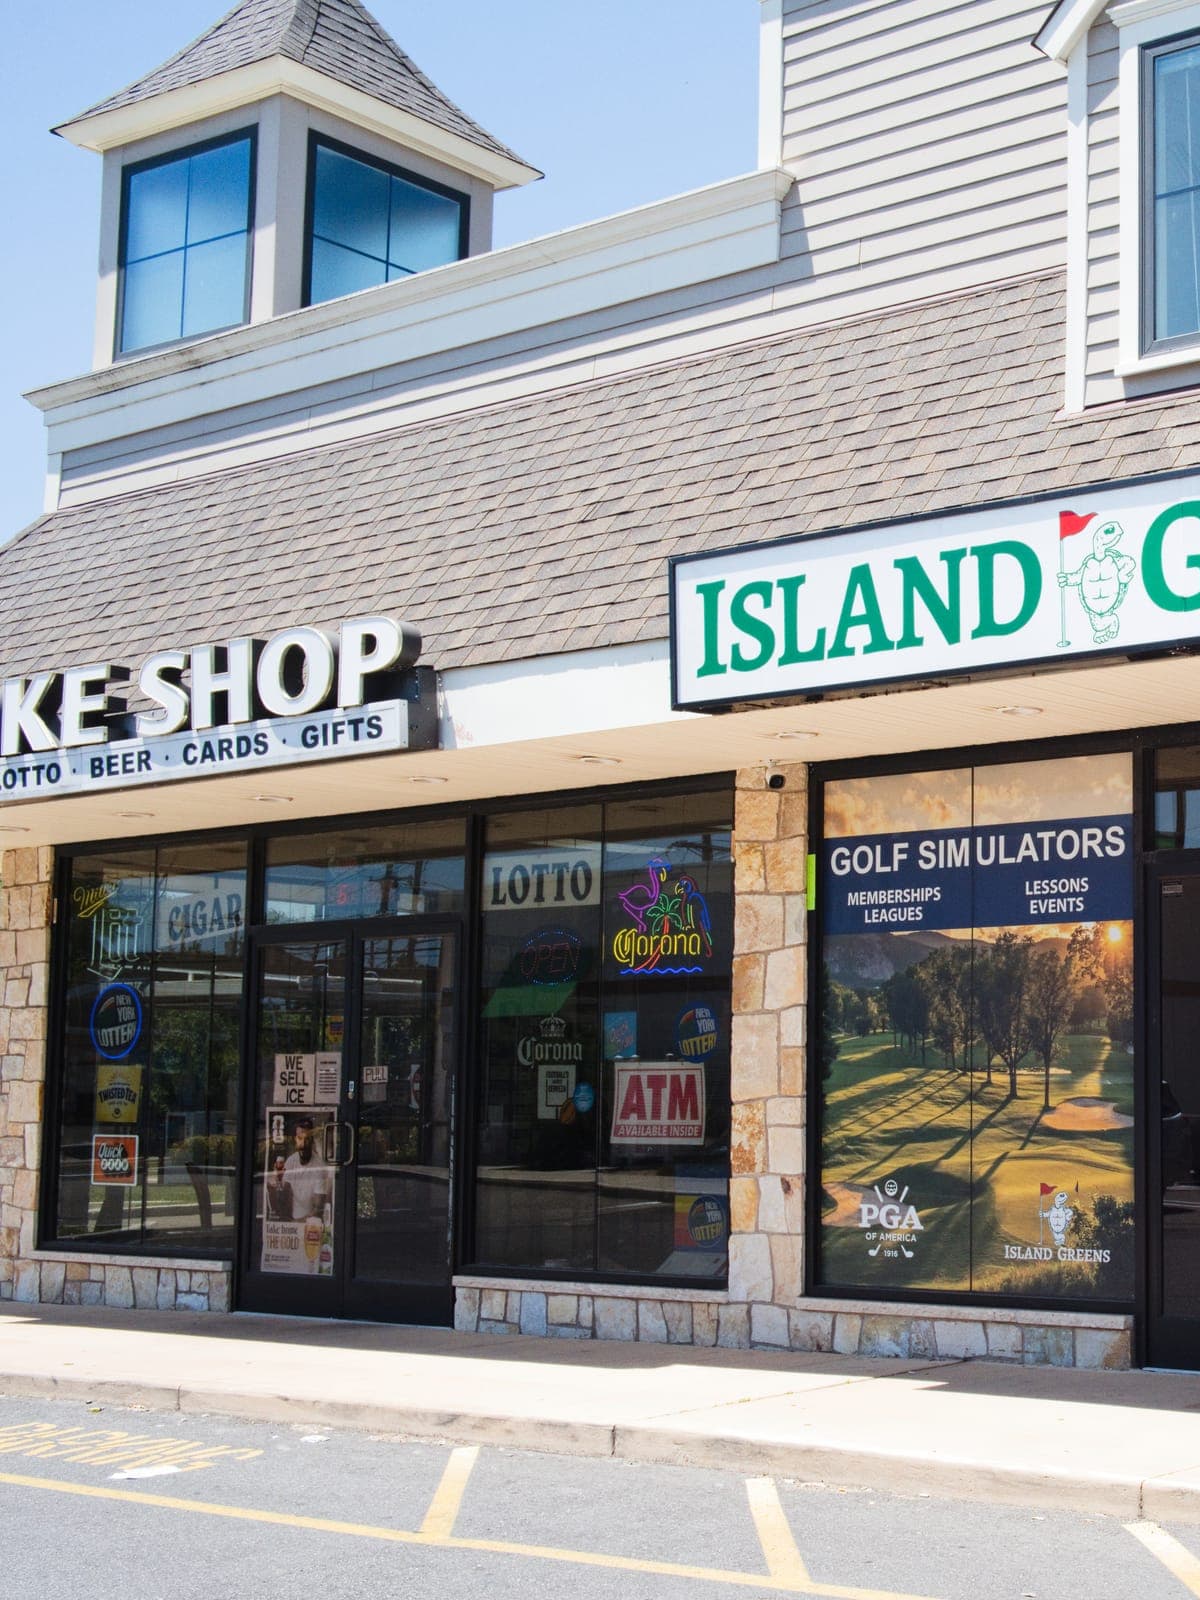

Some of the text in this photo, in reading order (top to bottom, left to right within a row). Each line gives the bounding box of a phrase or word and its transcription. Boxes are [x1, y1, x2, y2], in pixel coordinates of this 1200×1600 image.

[695, 538, 1044, 679] ISLAND
[137, 615, 405, 737] SHOP
[0, 714, 383, 790] OTTO BEER CARDS GIFTS
[830, 825, 1126, 876] GOLF SIMULATORS
[491, 860, 593, 905] LOTTO
[1025, 877, 1089, 895] LESSONS
[847, 886, 942, 906] MEMBERSHIPS
[1029, 896, 1084, 914] EVENTS
[168, 893, 242, 942] CIGAR
[864, 906, 923, 923] LEAGUES
[613, 927, 701, 968] Corona
[117, 1006, 136, 1022] YORK
[516, 1034, 583, 1069] Corona
[285, 1055, 304, 1070] WE
[279, 1071, 309, 1086] SELL
[365, 1067, 387, 1081] PULL
[286, 1088, 304, 1103] ICE
[619, 1073, 700, 1121] ATM
[617, 1123, 700, 1137] AVAILABLE INSIDE
[98, 1142, 124, 1158] Quick
[858, 1204, 924, 1231] PGA
[266, 1235, 279, 1249] THE
[280, 1235, 300, 1250] GOLD
[865, 1232, 917, 1243] OF AMERICA
[883, 1249, 899, 1258] 1916
[1004, 1245, 1111, 1264] ISLAND GREENS
